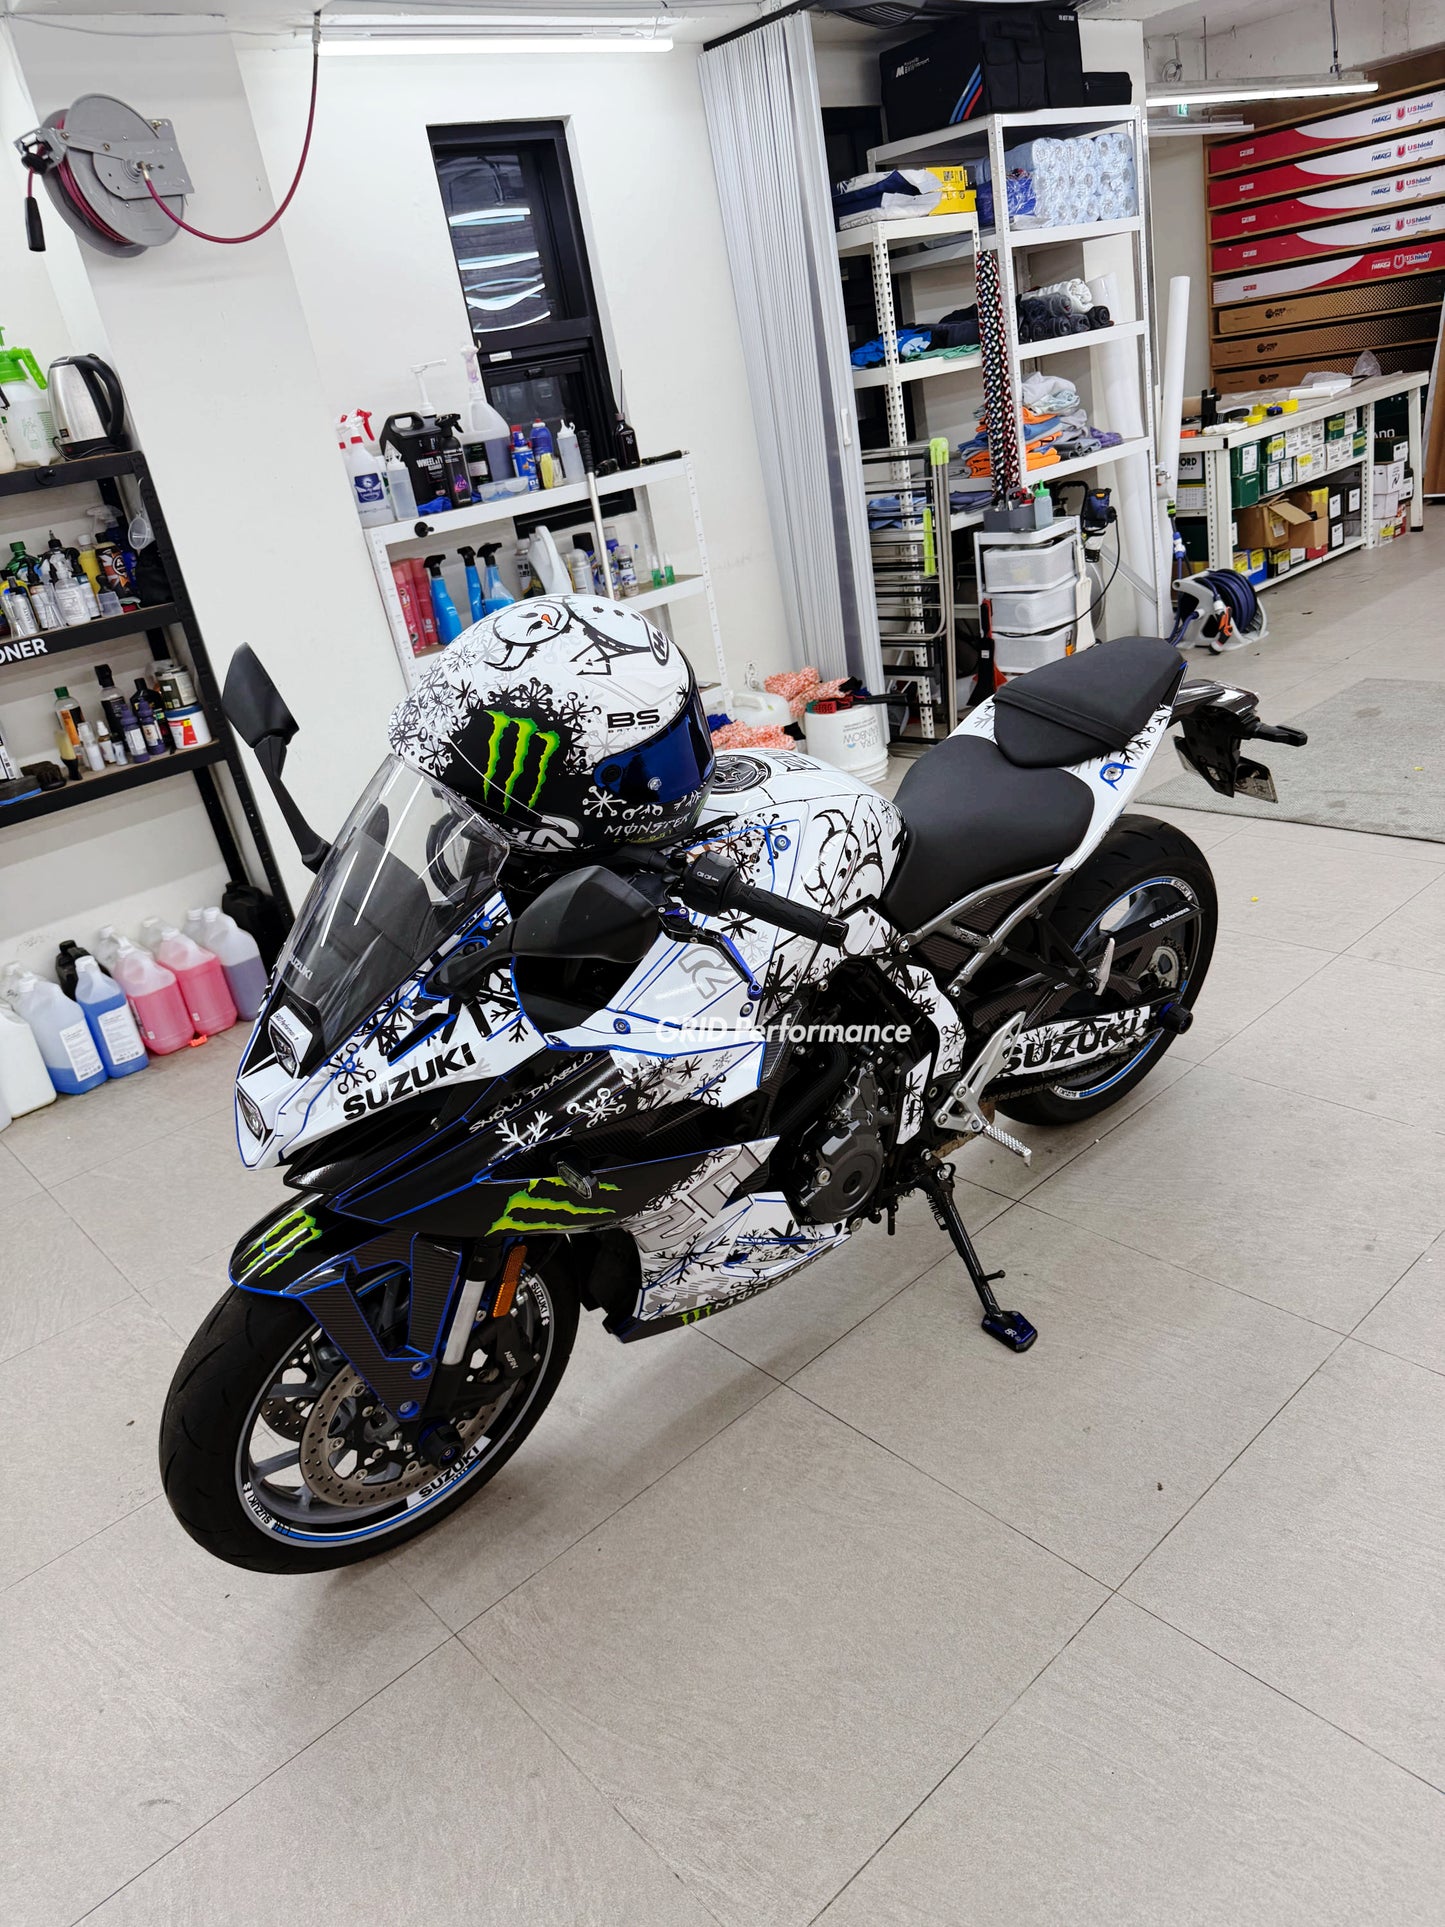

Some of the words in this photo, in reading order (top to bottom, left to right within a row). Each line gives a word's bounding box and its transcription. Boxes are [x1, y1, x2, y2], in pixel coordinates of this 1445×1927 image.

[607, 709, 660, 728] BS
[608, 725, 660, 733] BATTERY
[343, 1043, 476, 1121] SUZUKI
[531, 1282, 548, 1314] SUZUKI
[418, 1445, 480, 1498] SUZUKI
[247, 1494, 272, 1524] SUZUKI
